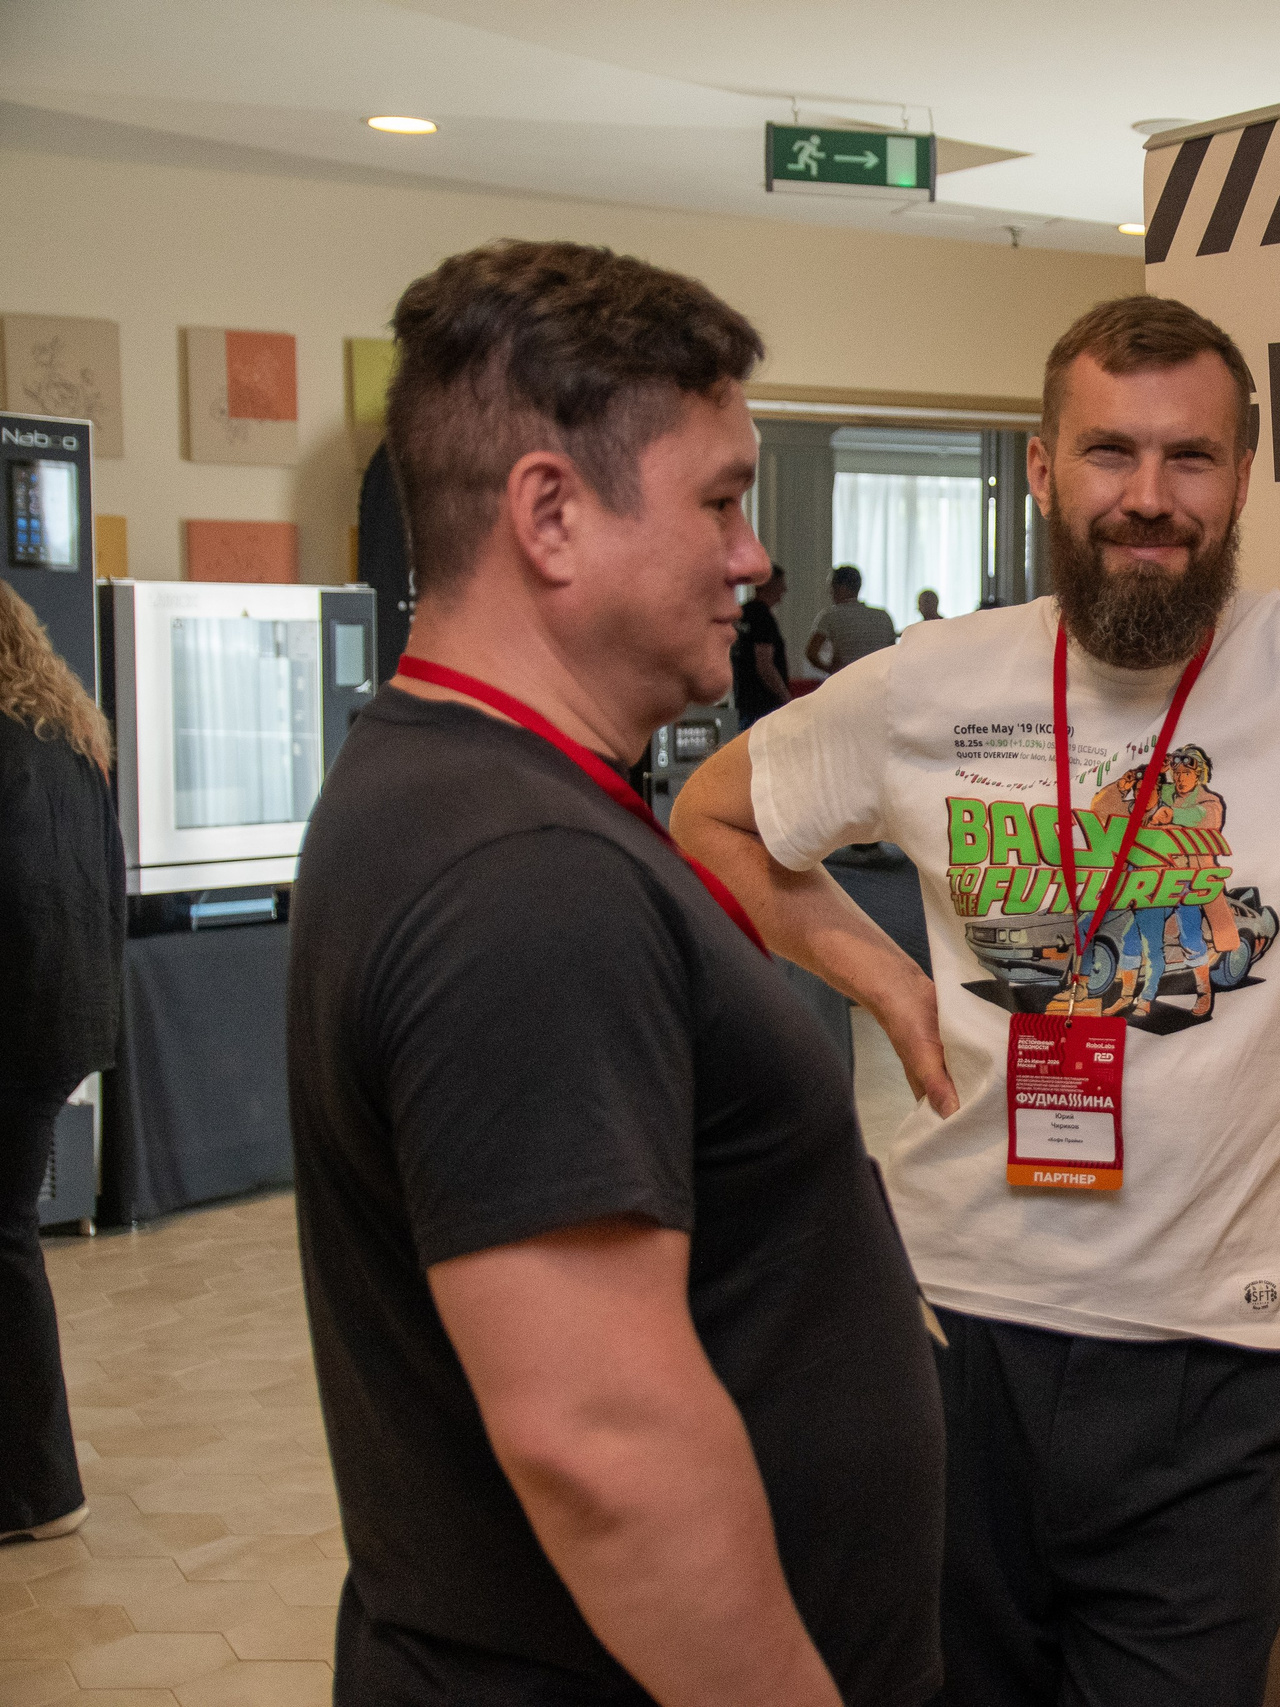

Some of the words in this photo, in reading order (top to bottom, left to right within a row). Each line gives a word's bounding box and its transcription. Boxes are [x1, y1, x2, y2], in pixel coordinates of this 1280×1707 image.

[953, 725, 989, 735] Coffee
[991, 724, 1014, 736] May
[954, 740, 983, 748] 88.25s
[956, 751, 982, 759] QUOTE
[983, 751, 1019, 759] OVERVIEW
[946, 796, 1232, 868] BACK
[947, 866, 982, 894] TO
[976, 866, 1233, 918] FUTURES
[952, 894, 978, 917] THE
[1055, 1113, 1075, 1122] Юрий
[1033, 1171, 1097, 1184] ПАРТНЕР
[1252, 1290, 1271, 1302] SFT
